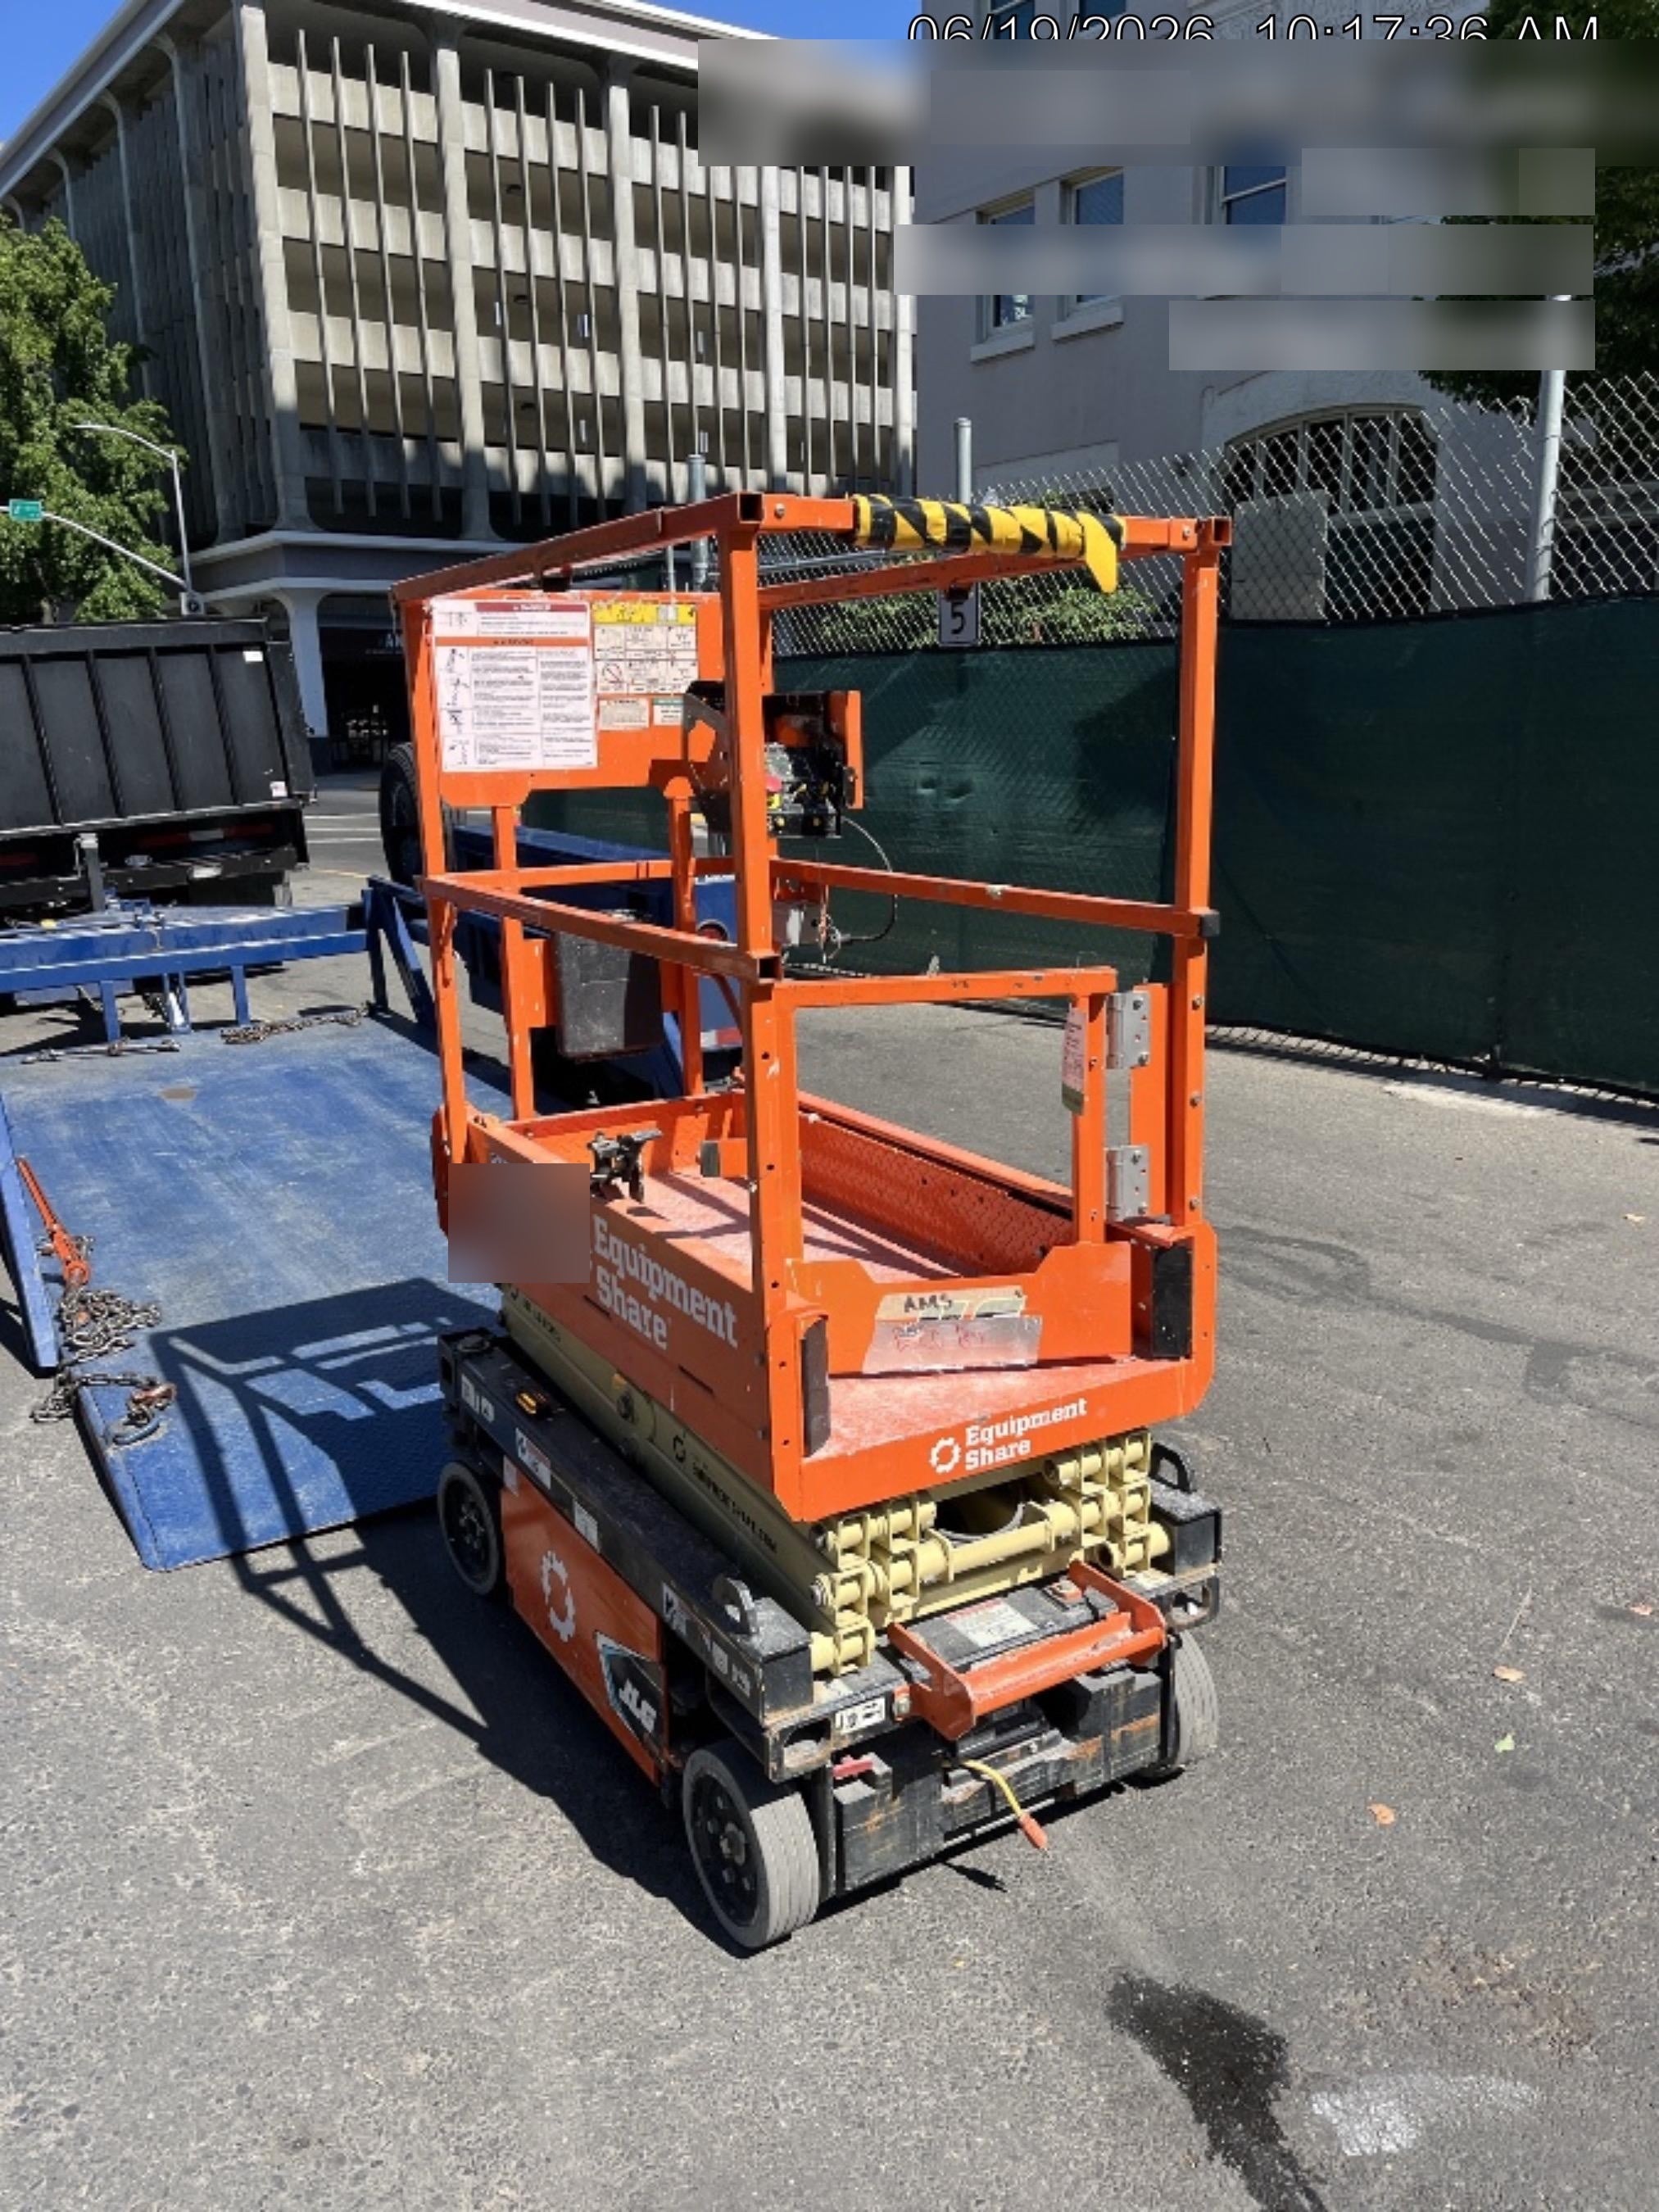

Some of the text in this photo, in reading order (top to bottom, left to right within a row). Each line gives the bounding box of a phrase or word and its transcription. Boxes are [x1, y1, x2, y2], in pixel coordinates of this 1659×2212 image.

[950, 602, 967, 634] 5
[593, 1214, 739, 1349] Equipment
[596, 1264, 669, 1351] Share
[964, 1398, 1088, 1447] Equipment
[964, 1439, 1031, 1471] Share
